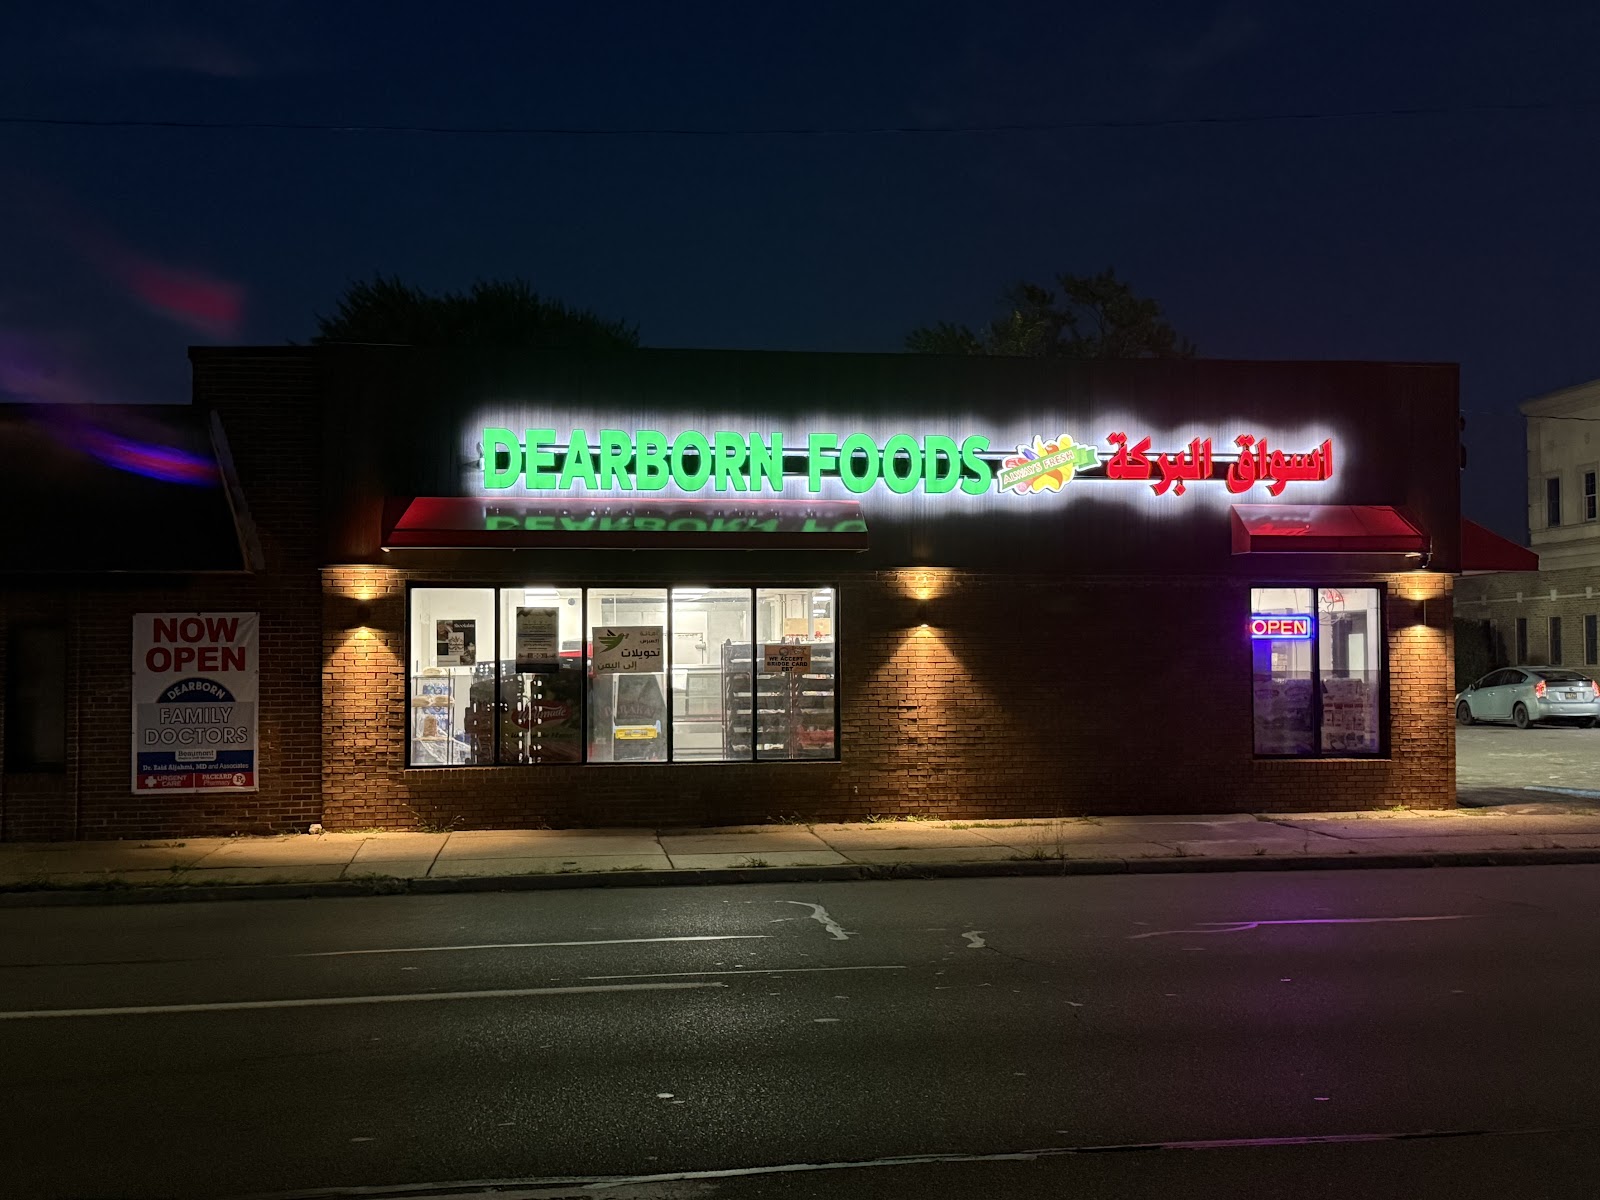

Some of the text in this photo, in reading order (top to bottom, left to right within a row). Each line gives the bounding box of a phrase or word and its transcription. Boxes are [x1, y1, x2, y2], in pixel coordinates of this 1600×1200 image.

[483, 428, 991, 495] DEARBORN FOODS
[1003, 449, 1075, 484] ALWAYS FRESH
[1106, 432, 1213, 497] البركة
[153, 617, 239, 643] NOW
[1251, 620, 1307, 635] OPEN
[145, 647, 246, 673] OPEN
[621, 648, 660, 659] تحويلات
[167, 681, 226, 700] DEARBORN
[159, 707, 233, 725] FAMILY
[145, 727, 248, 745] DOCTORS
